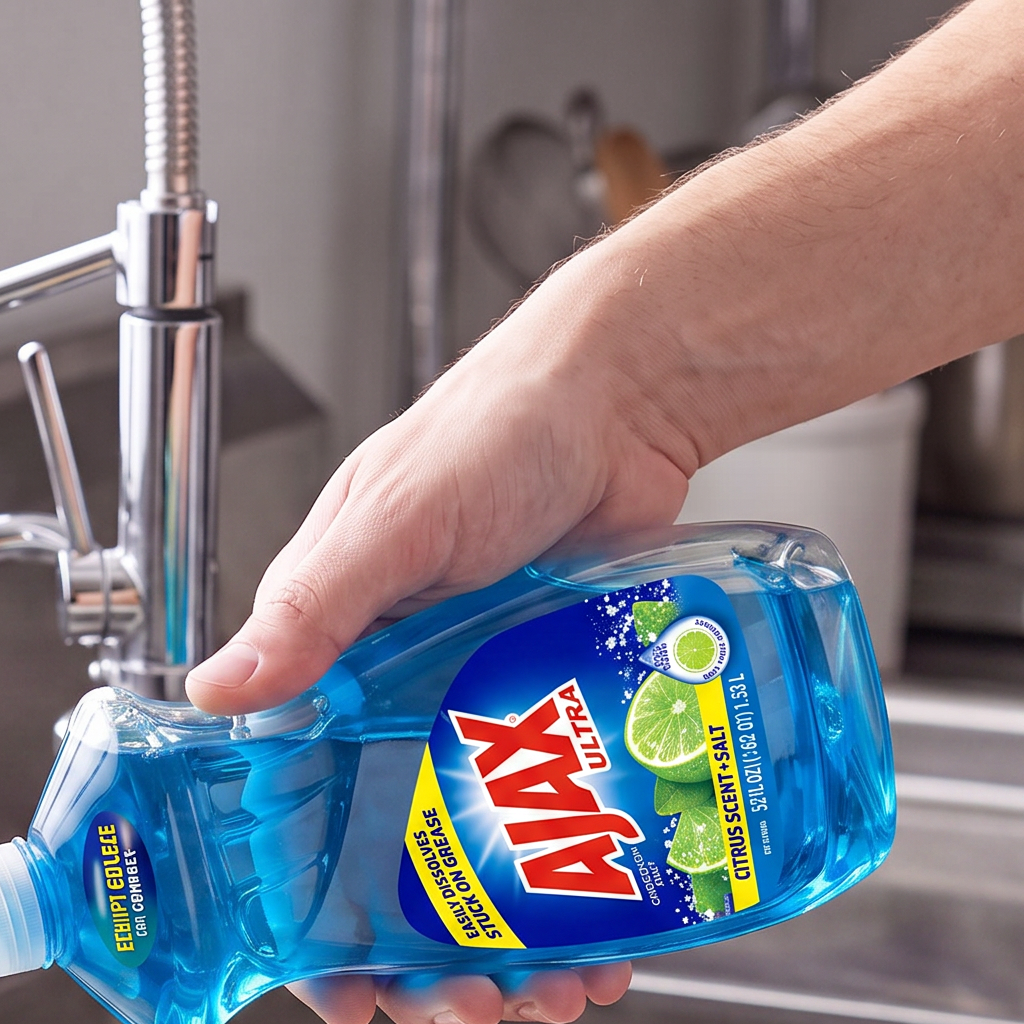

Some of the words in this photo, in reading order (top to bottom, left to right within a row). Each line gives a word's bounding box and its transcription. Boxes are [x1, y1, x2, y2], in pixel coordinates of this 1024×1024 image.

[558, 684, 607, 770] ULTRA
[454, 697, 640, 895] AJAX
[717, 773, 742, 824] SCENT
[413, 830, 456, 899] DISSOLVES
[421, 807, 458, 868] GREASE
[726, 824, 751, 880] CITRUS
[448, 870, 471, 893] ON
[446, 901, 480, 939] EASILY
[461, 893, 503, 939] STUCK
